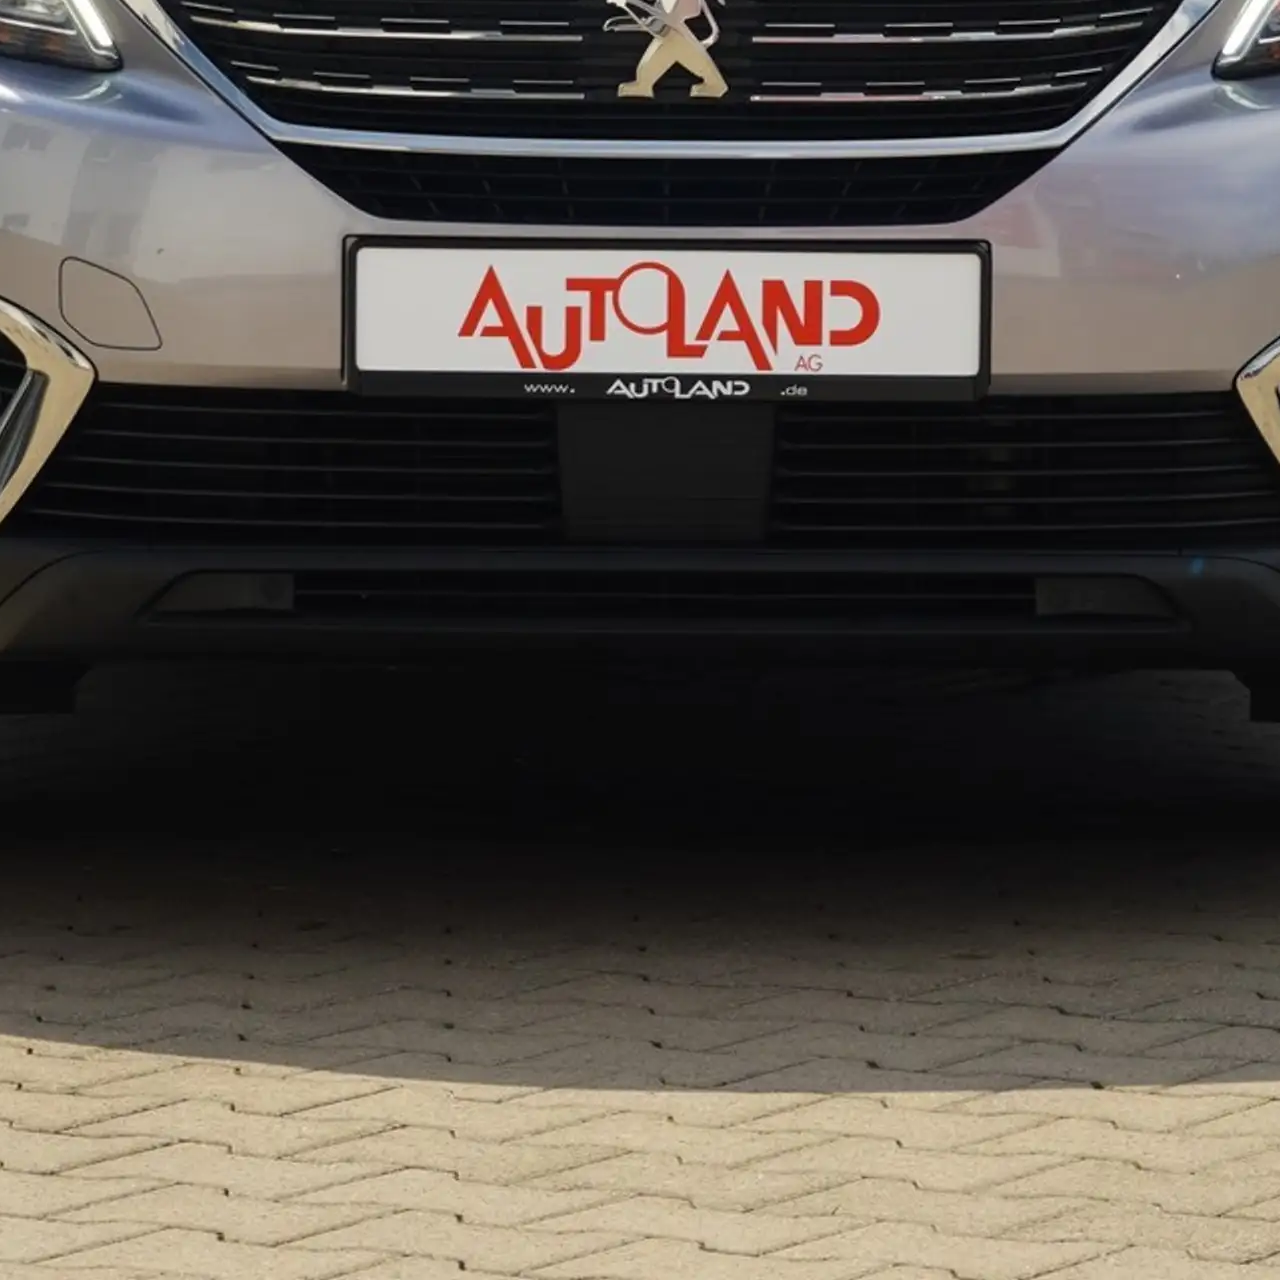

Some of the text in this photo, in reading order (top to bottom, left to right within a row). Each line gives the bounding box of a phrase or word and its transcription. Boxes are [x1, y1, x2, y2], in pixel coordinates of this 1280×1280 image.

[458, 260, 881, 372] AUTOLAND
[794, 353, 823, 372] AG
[523, 376, 809, 400] www. AUTOLAND .de
